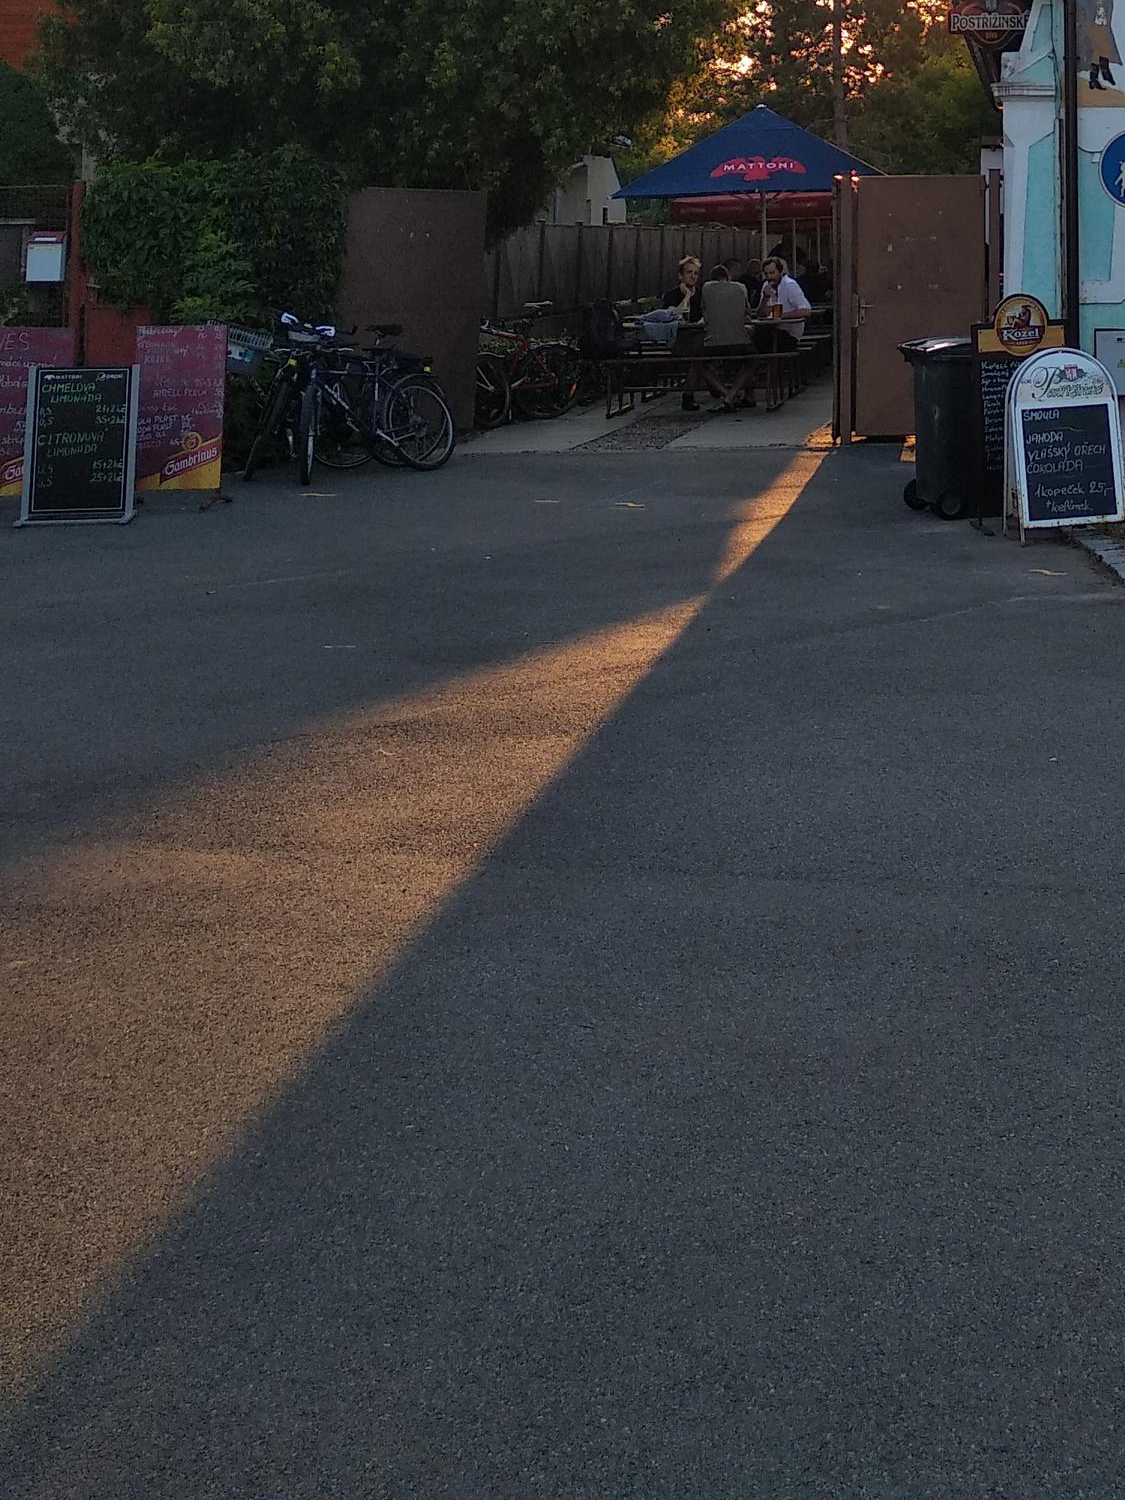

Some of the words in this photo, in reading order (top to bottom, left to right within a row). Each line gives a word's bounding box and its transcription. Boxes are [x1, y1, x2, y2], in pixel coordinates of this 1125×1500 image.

[723, 162, 794, 171] MATTONI
[1002, 328, 1040, 341] Kozel
[1025, 431, 1064, 444] JAHODA
[1074, 441, 1106, 456] OŘECH
[163, 447, 218, 476] Gambrinus
